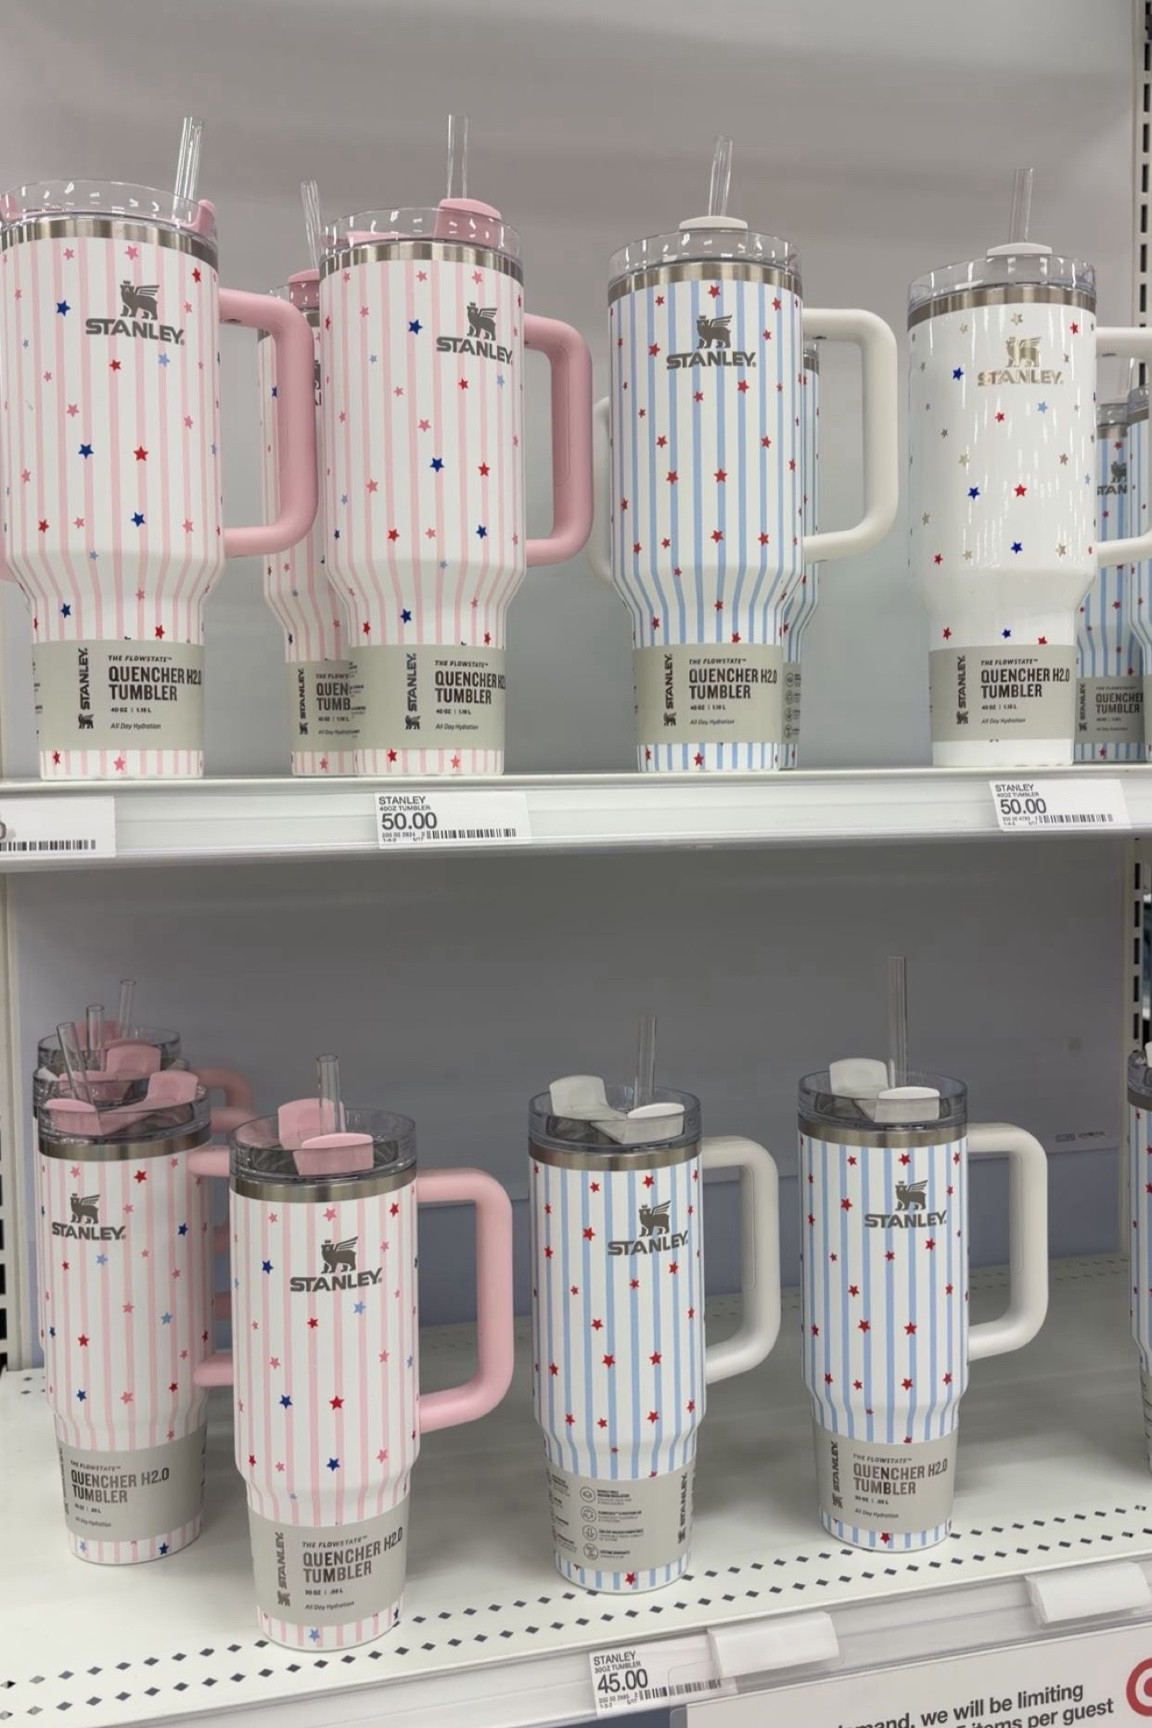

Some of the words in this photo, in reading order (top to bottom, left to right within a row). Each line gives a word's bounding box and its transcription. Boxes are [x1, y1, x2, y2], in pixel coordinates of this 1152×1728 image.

[86, 318, 185, 346] STANLEY
[436, 336, 513, 365] STANLEY
[666, 351, 756, 370] STANLEY
[977, 369, 1064, 387] STANLEY
[108, 666, 185, 684] QUENCHER
[435, 670, 497, 689] QUENCHER
[689, 668, 758, 684] QUENCHER
[760, 669, 777, 684] H2.0
[981, 668, 1051, 683] QUENCHER
[1052, 668, 1070, 682] H2.0
[109, 684, 178, 701] TUMBLER
[316, 683, 349, 696] QUEN
[435, 687, 492, 705] TUMBLER
[689, 685, 751, 700] TUMBLER
[981, 684, 1043, 699] TUMBLER
[316, 698, 351, 711] TUMB
[1095, 703, 1140, 714] TUMBLER
[995, 783, 1034, 792] STANLEY
[378, 795, 426, 805] STANLEY
[1000, 798, 1047, 815] 50.00
[381, 812, 438, 830] 50.00
[864, 1209, 947, 1229] STANLEY
[52, 1221, 127, 1241] STANLEY
[607, 1229, 688, 1256] STANLEY
[290, 1267, 383, 1292] STANLEY
[70, 1469, 137, 1489] QUENCHER
[141, 1467, 170, 1486] H2.0
[853, 1462, 925, 1481] QUENCHER
[927, 1458, 948, 1477] H2.0
[71, 1484, 128, 1504] TUMBLER
[853, 1477, 916, 1496] TUMBLER
[303, 1540, 381, 1567] QUENCHER
[383, 1526, 403, 1551] H2.0
[303, 1560, 372, 1584] TUMBLER
[593, 1650, 636, 1666] STANLEY
[611, 1661, 641, 1671] TUMBLER
[597, 1668, 648, 1694] 45.00
[920, 1709, 948, 1727] we
[953, 1699, 984, 1721] will
[989, 1697, 1013, 1714] be
[1017, 1684, 1084, 1709] limiting
[1028, 1710, 1058, 1728] per
[1062, 1697, 1114, 1726] guest
